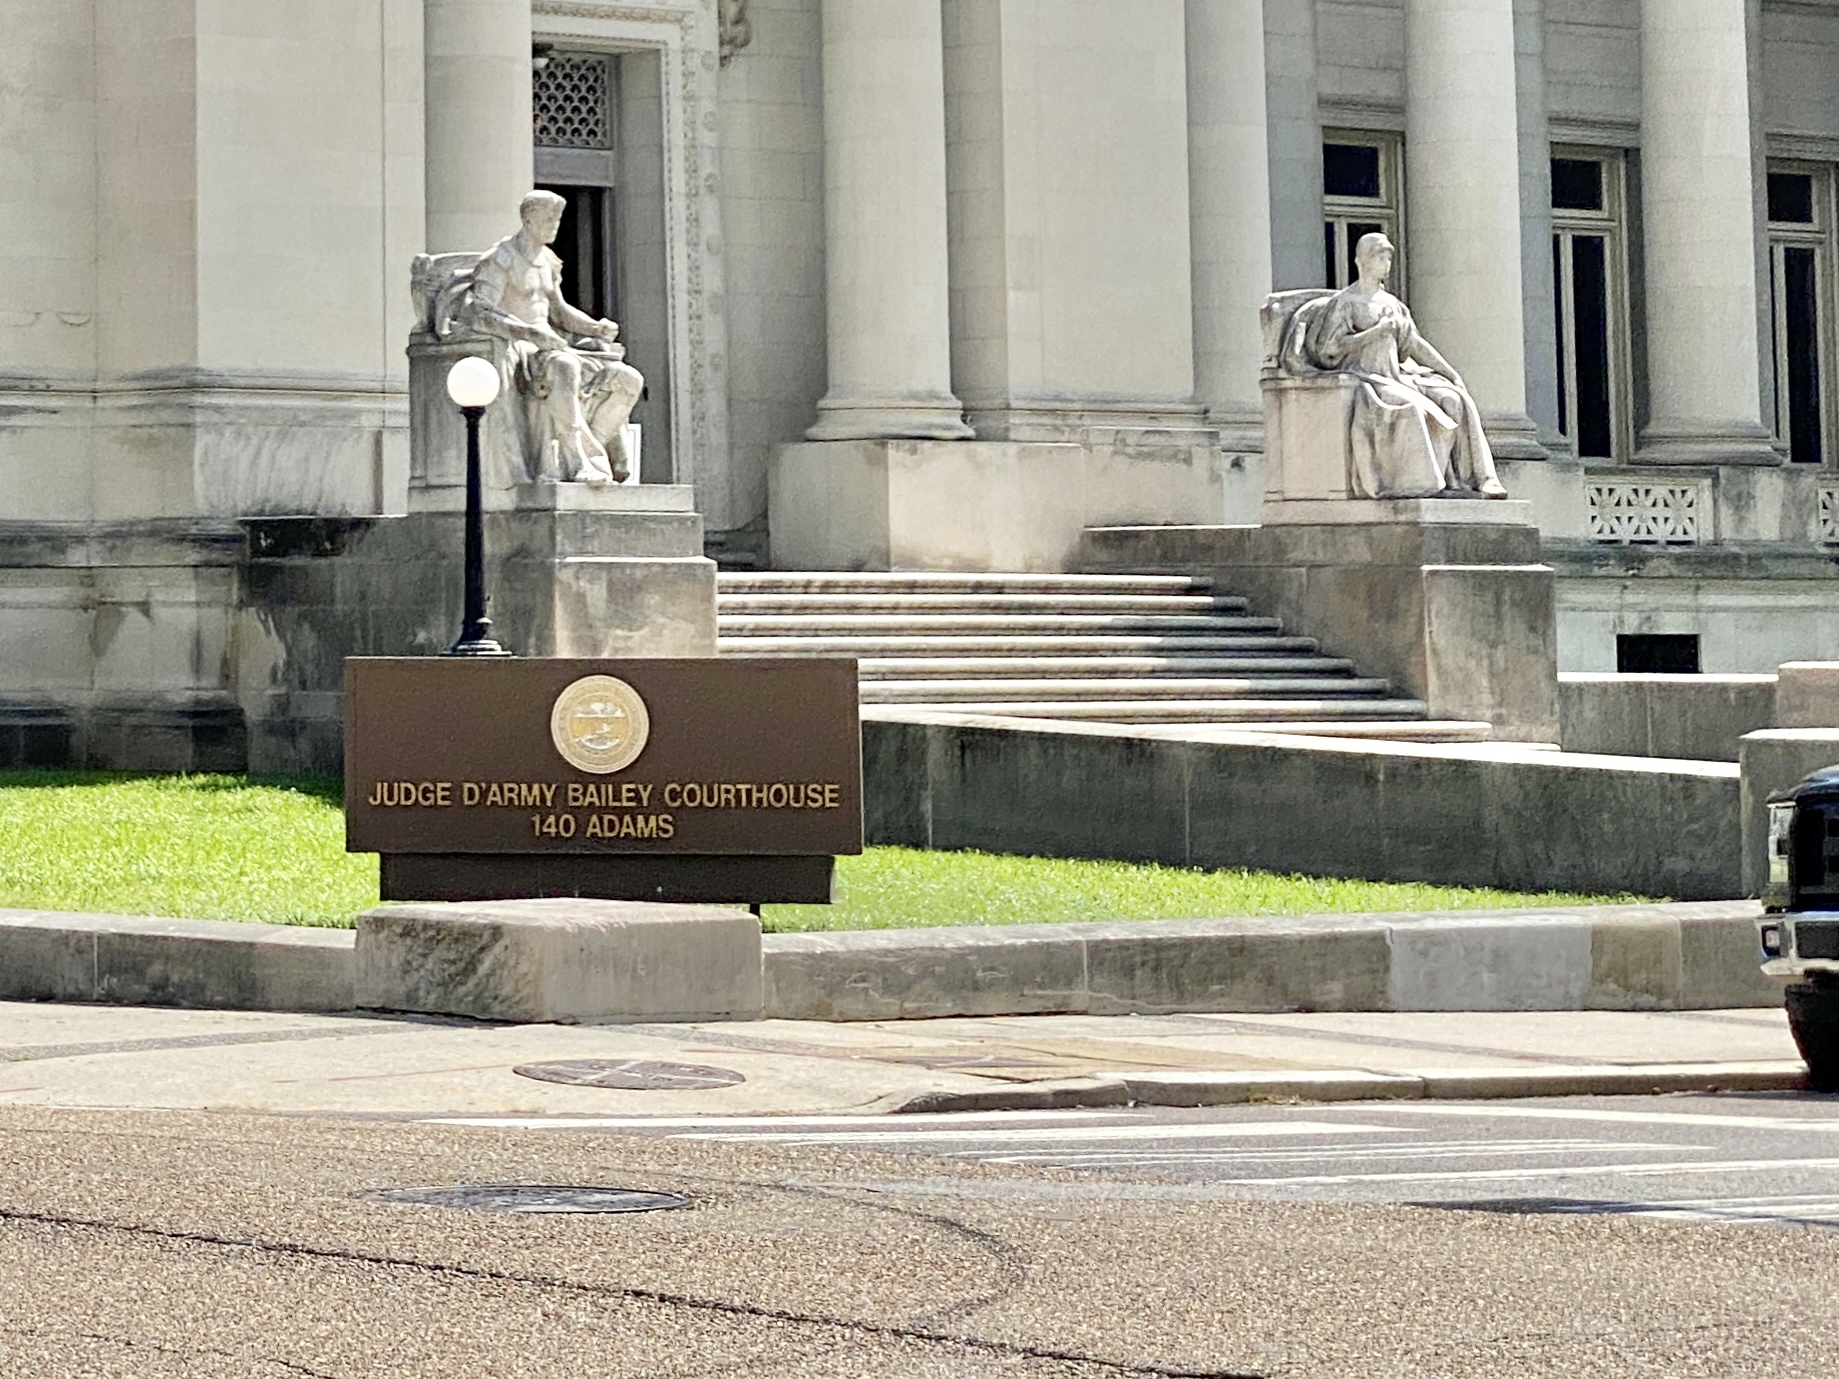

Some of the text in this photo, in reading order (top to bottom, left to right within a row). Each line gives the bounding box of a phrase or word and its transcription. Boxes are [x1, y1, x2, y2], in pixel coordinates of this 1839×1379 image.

[368, 782, 840, 808] JUDGE D'ARMY BAILEY COURTHOUSE
[531, 814, 674, 838] 140 ADAMS
